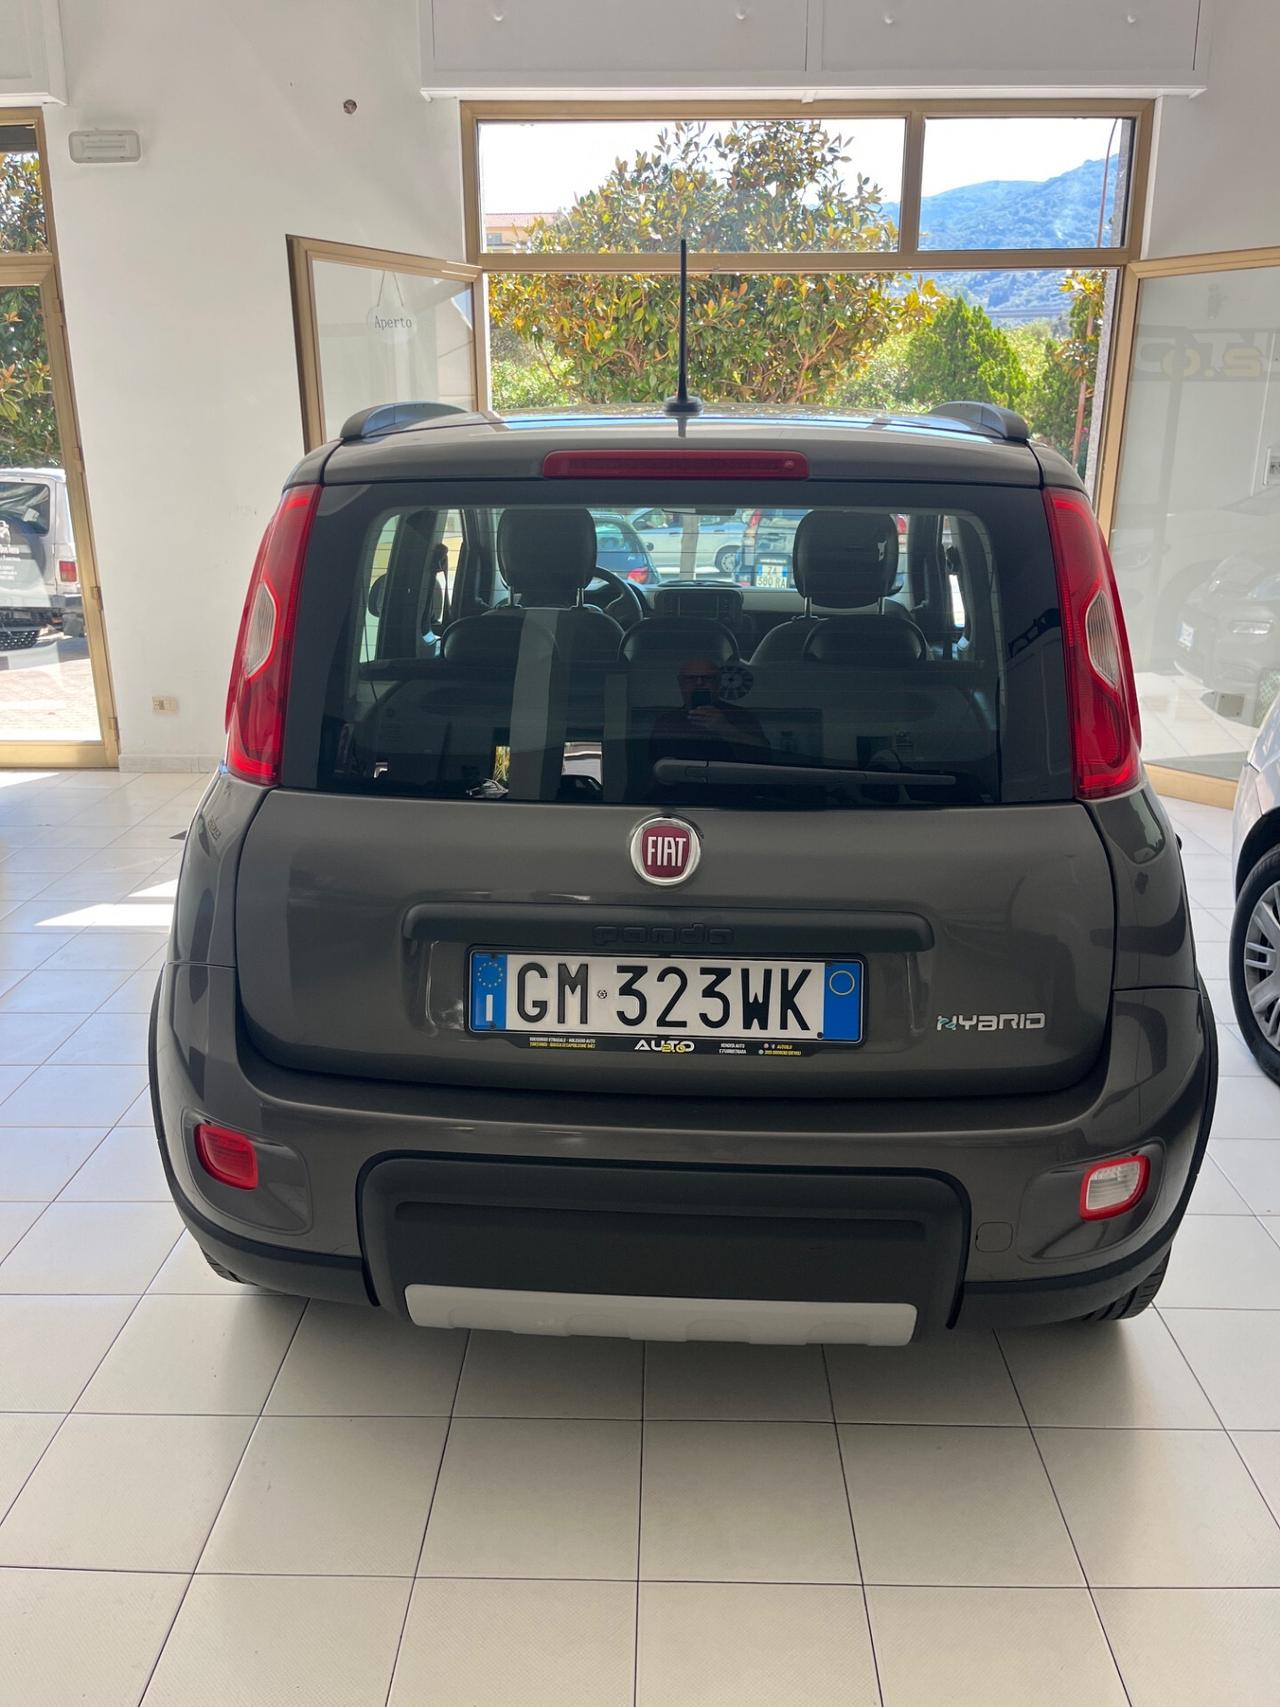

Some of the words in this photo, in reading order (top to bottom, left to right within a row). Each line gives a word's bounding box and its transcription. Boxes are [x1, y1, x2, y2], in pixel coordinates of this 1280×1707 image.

[374, 315, 412, 330] Aperto
[647, 836, 687, 867] FIAT
[516, 962, 589, 1025] GM
[616, 964, 812, 1031] 323WK
[936, 1012, 1046, 1031] HYBRID
